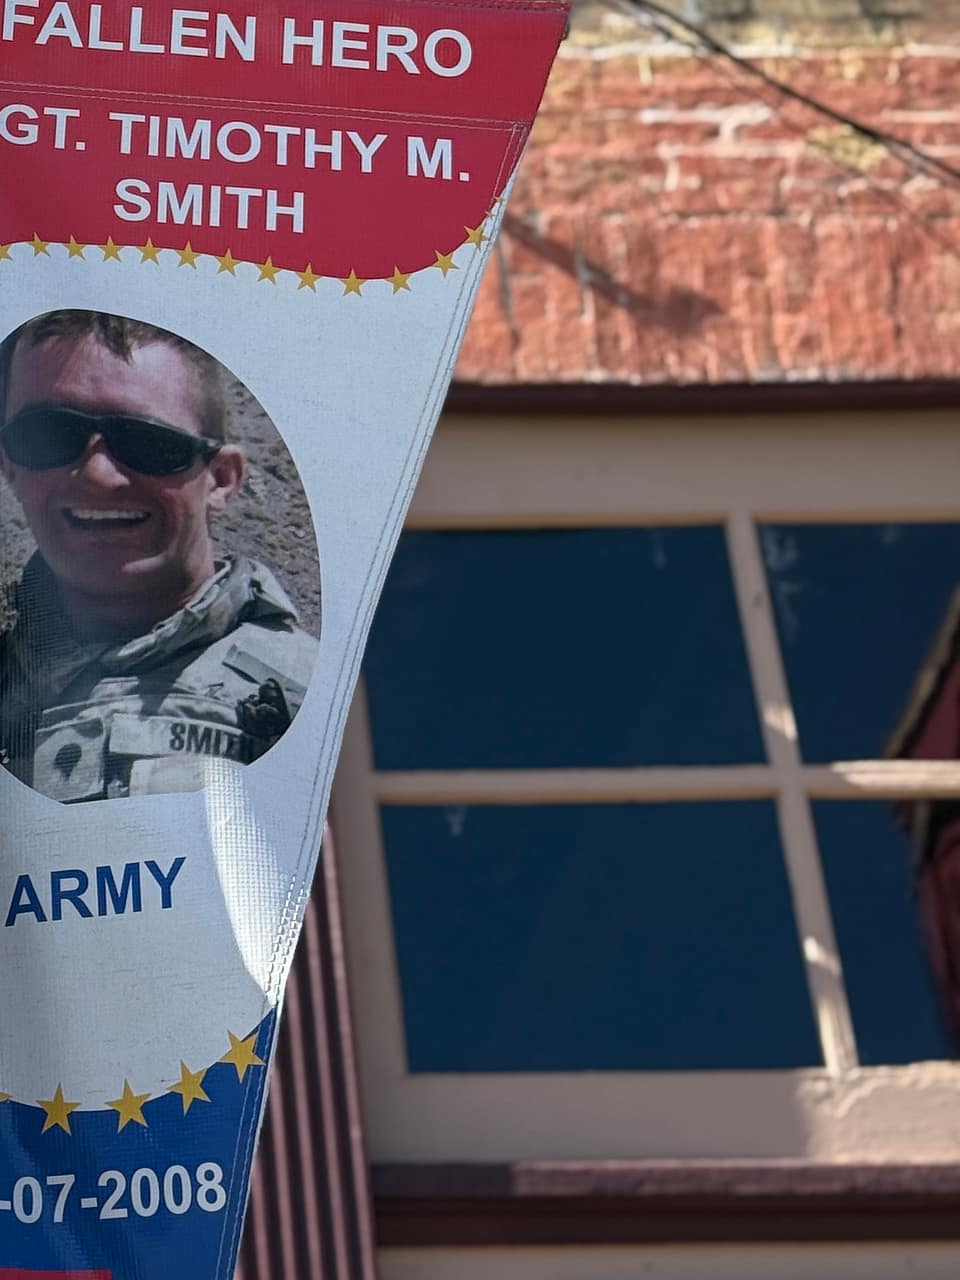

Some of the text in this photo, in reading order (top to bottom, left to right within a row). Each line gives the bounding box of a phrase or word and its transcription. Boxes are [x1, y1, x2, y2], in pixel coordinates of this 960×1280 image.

[282, 17, 472, 77] HERO
[109, 111, 389, 174] TIMOTHY
[407, 136, 471, 182] M.
[113, 178, 305, 234] SMITH
[5, 857, 187, 927] ARMY
